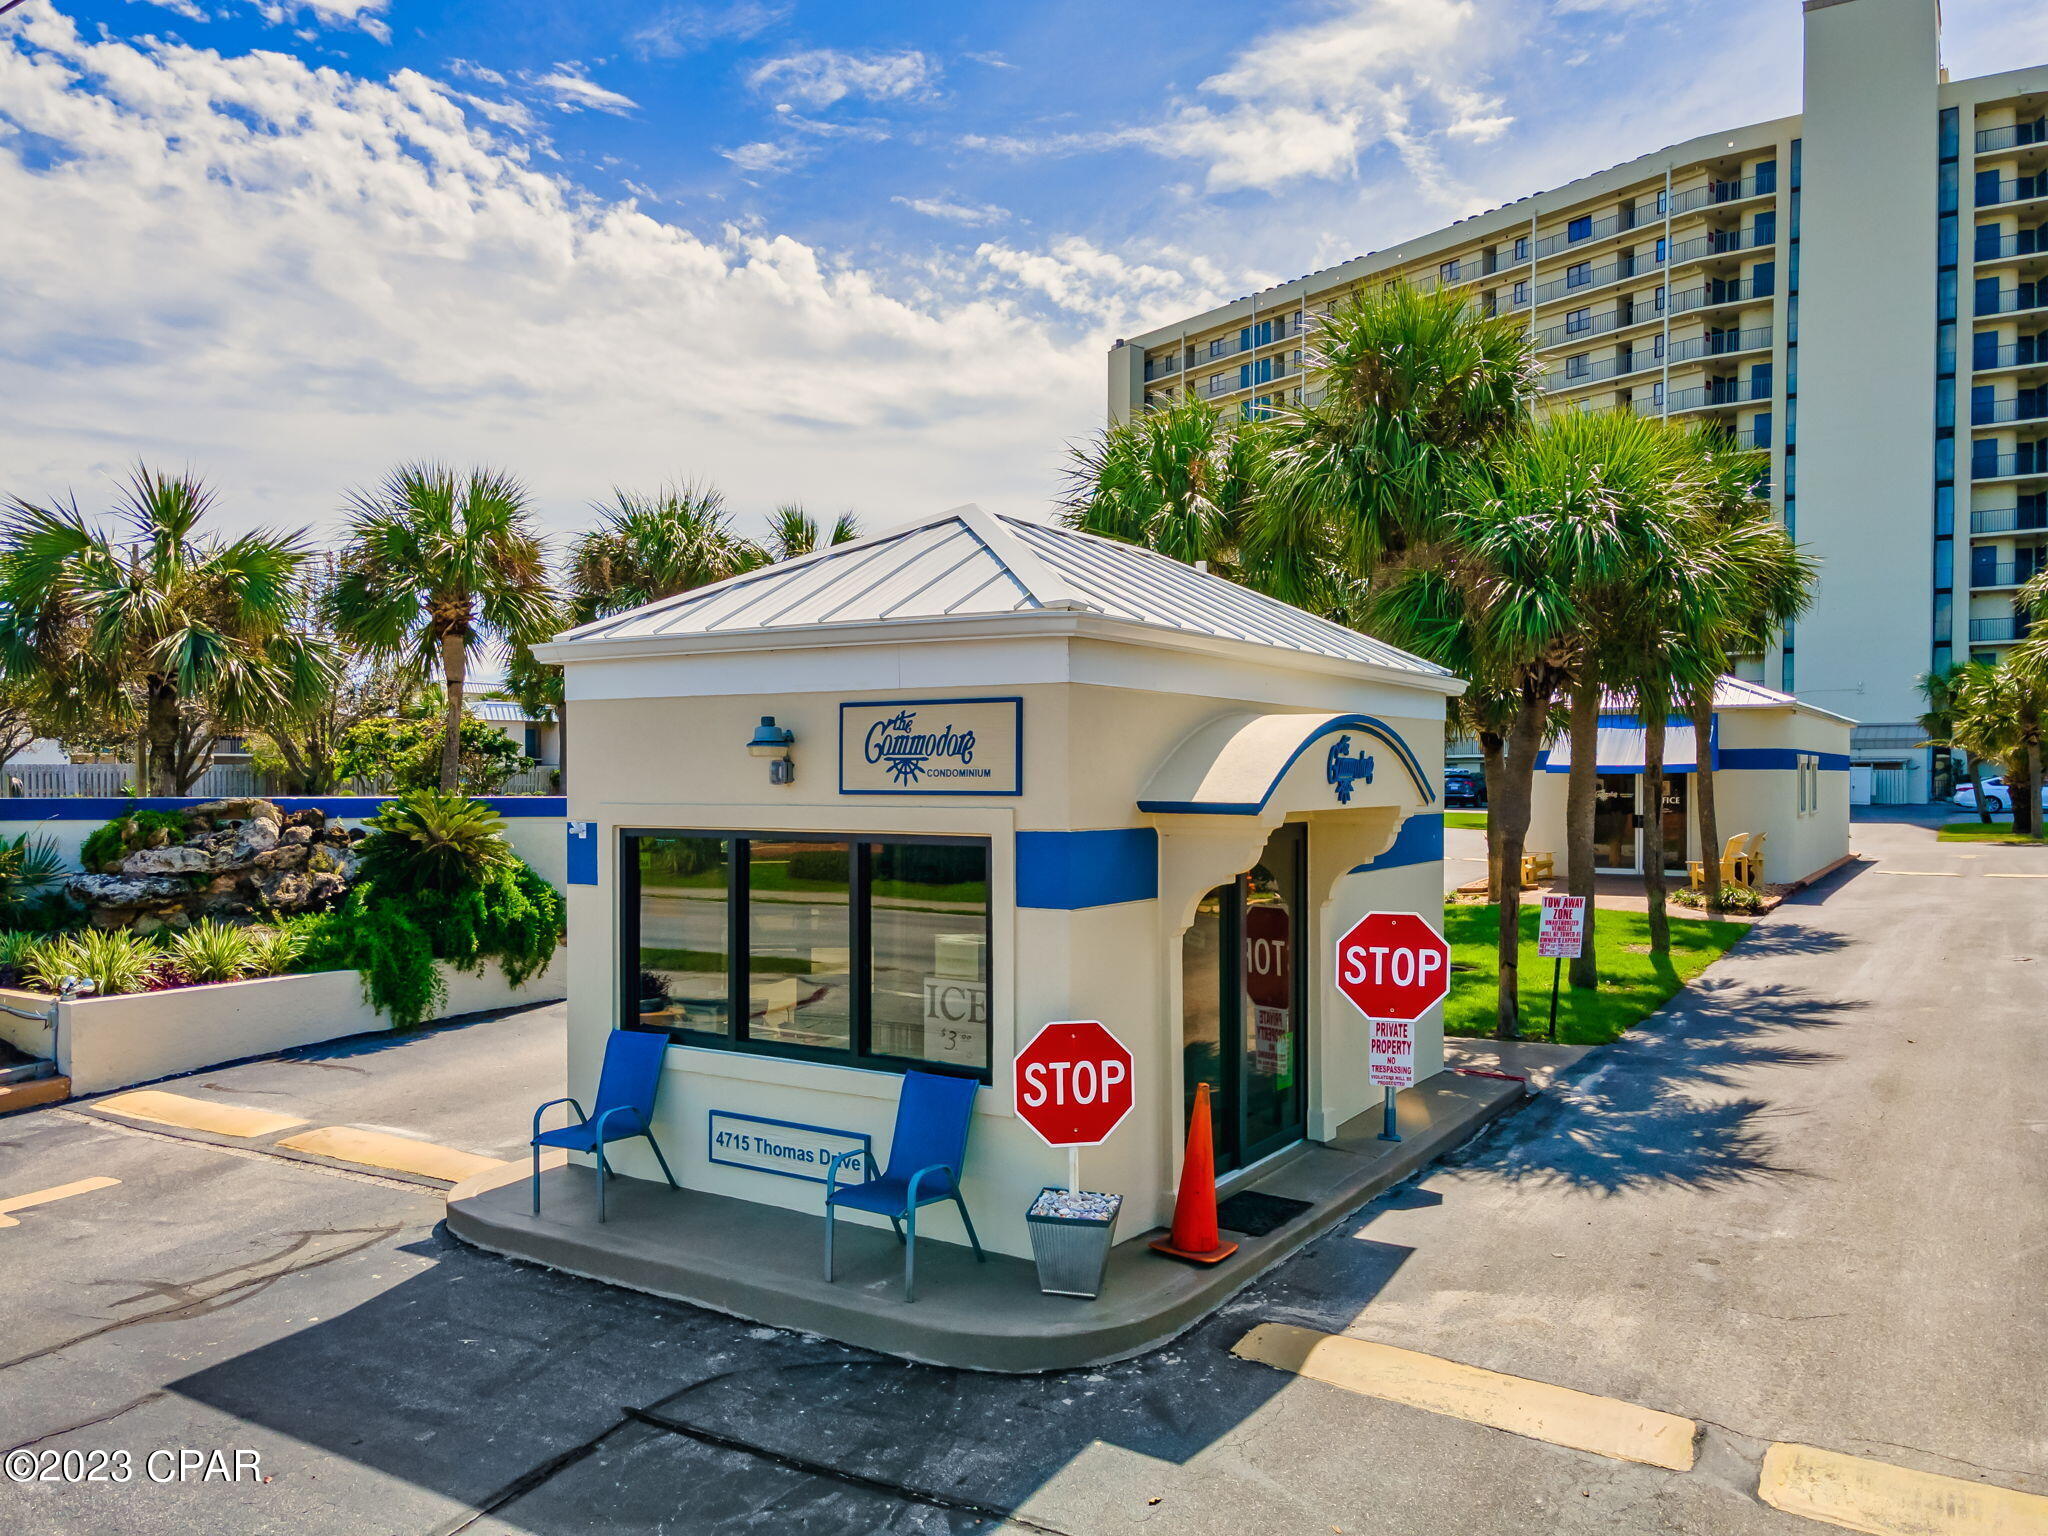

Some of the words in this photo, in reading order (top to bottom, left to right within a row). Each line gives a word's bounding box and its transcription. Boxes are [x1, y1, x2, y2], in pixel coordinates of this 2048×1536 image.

[892, 710, 917, 733] the
[865, 720, 976, 764] Commodore
[926, 768, 991, 778] CONDOMINIUM
[1662, 796, 1680, 804] FICE
[1544, 897, 1561, 908] TOW
[1563, 897, 1584, 909] AWAY
[1553, 909, 1573, 919] ZONE
[1344, 945, 1442, 987] STOP
[926, 984, 987, 1024] ICE
[1376, 1022, 1408, 1038] PRIVATE
[1371, 1038, 1412, 1055] PROPERTY
[1386, 1056, 1396, 1064] NO
[1371, 1065, 1412, 1075] TRESPASSING
[1023, 1060, 1126, 1107] STOP
[716, 1131, 750, 1151] 4715
[754, 1137, 814, 1163] Thomas
